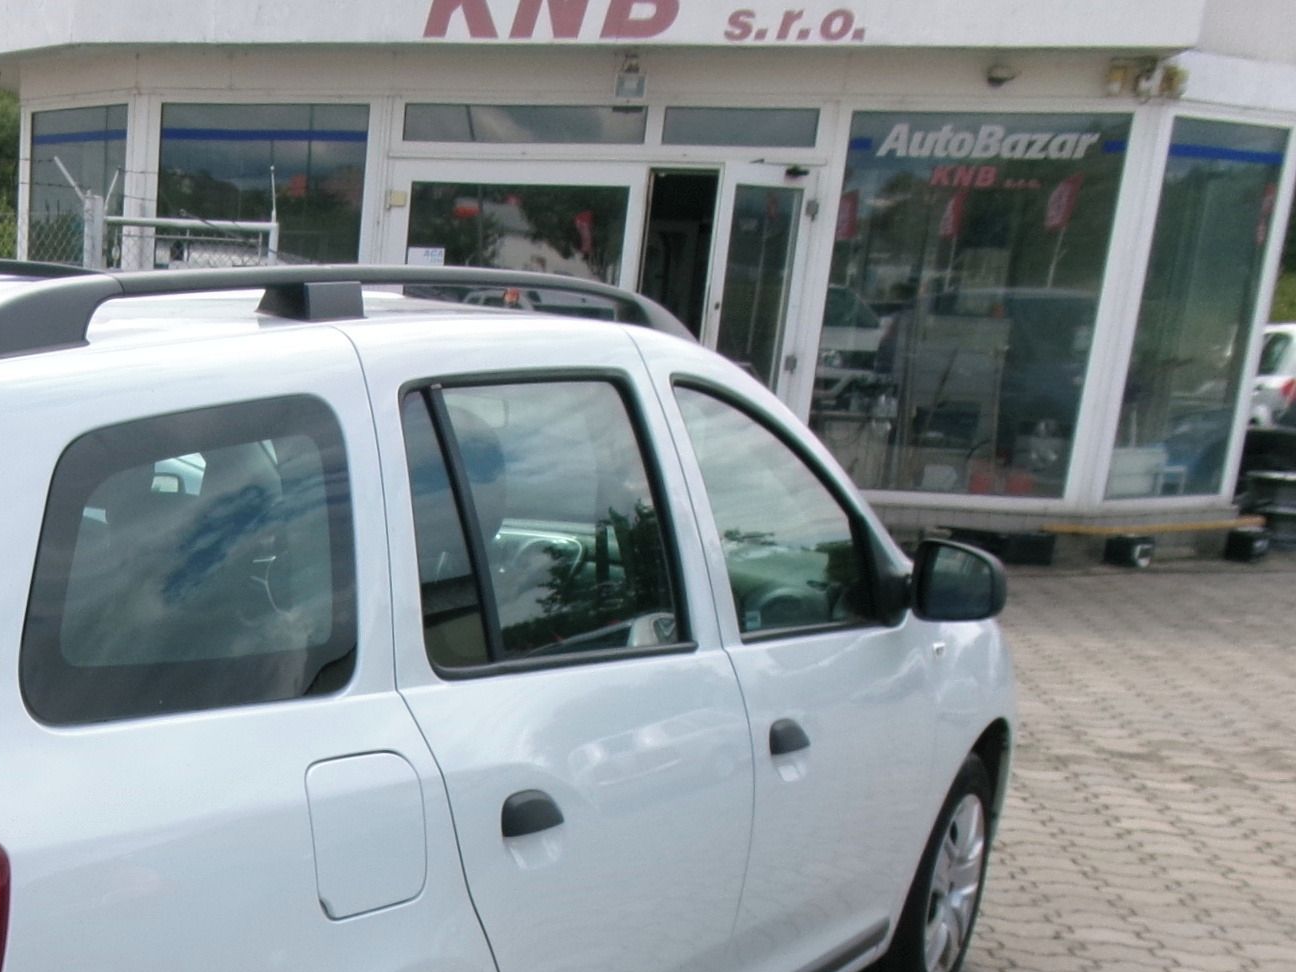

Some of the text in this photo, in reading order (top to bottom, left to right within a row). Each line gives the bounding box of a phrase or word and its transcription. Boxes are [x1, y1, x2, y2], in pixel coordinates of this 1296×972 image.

[422, 0, 866, 41] KNB s.r.o.
[876, 123, 1101, 160] AutoBazar
[930, 166, 997, 188] KNB
